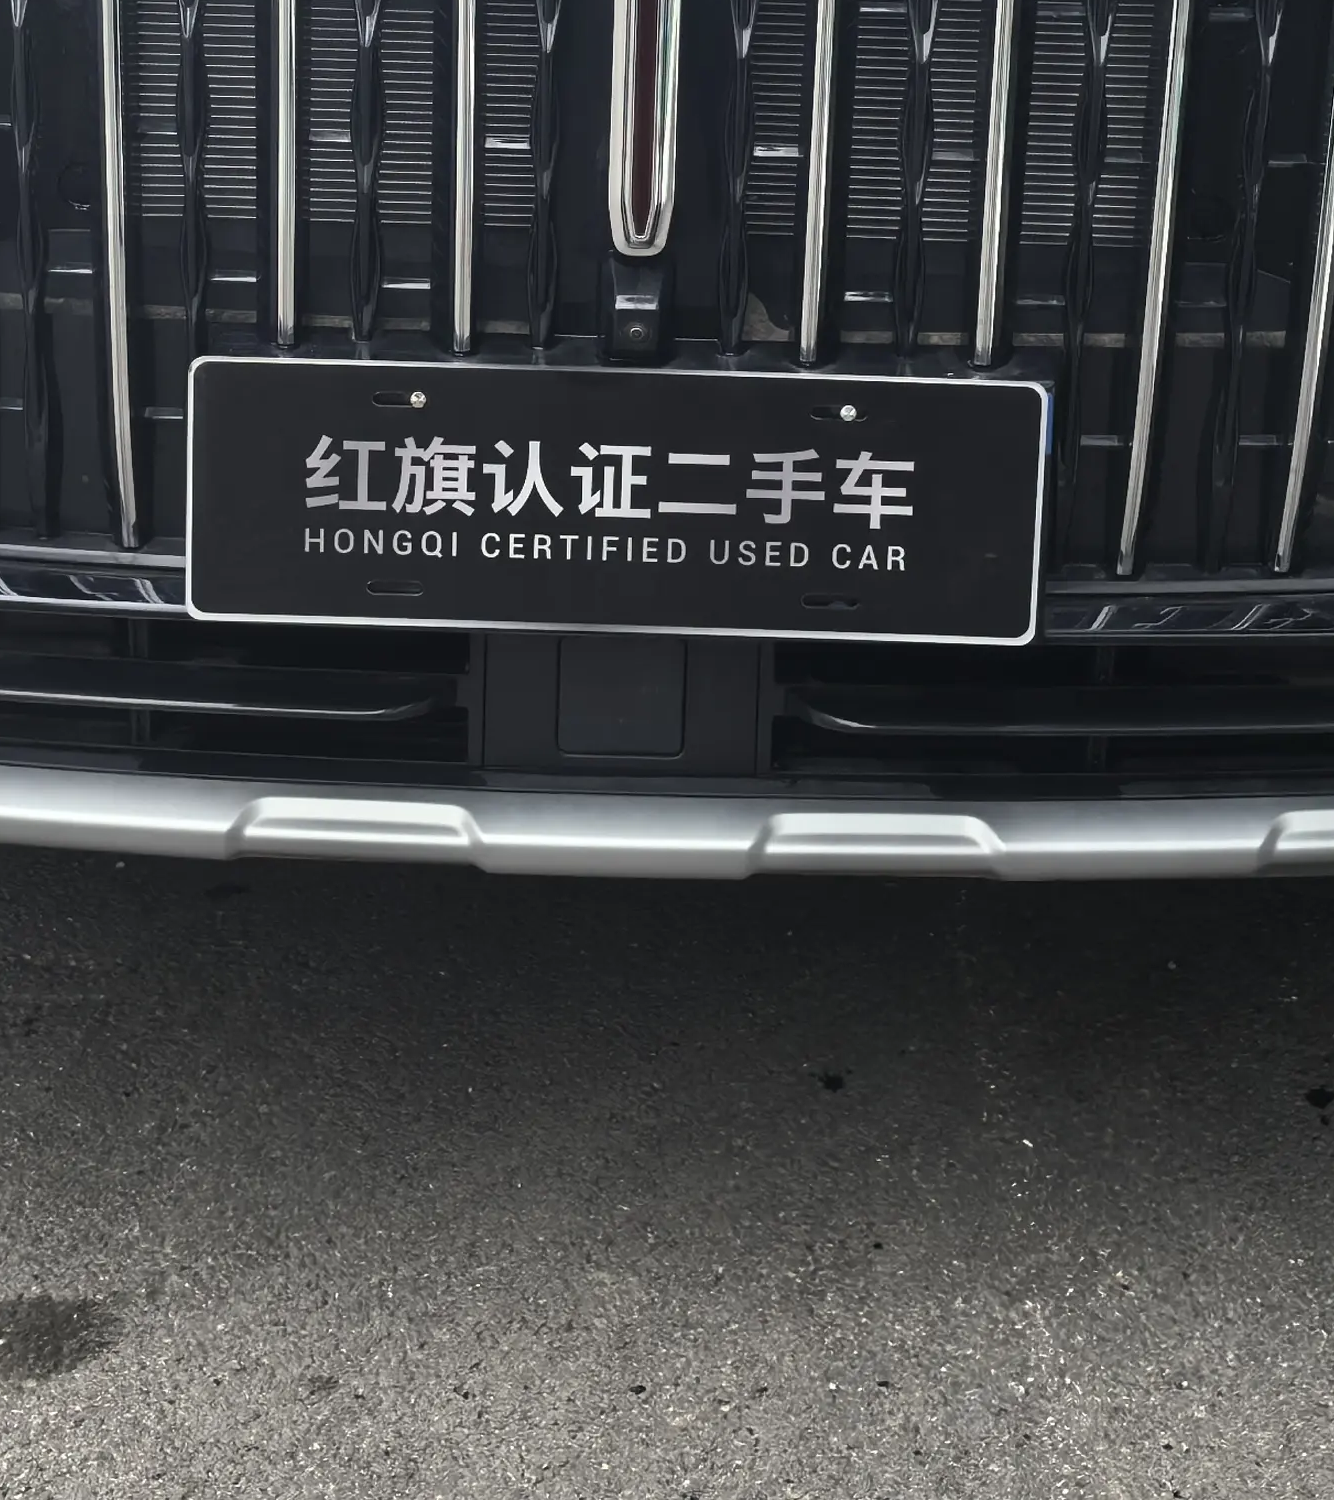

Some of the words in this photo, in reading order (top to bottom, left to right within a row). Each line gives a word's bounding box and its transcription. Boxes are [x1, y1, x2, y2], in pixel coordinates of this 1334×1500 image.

[305, 434, 915, 529] 红旗认证二手车
[304, 528, 458, 559] HONGQI
[480, 532, 688, 564] CERTIFIED
[709, 540, 809, 568] USED
[831, 543, 906, 571] CAR
